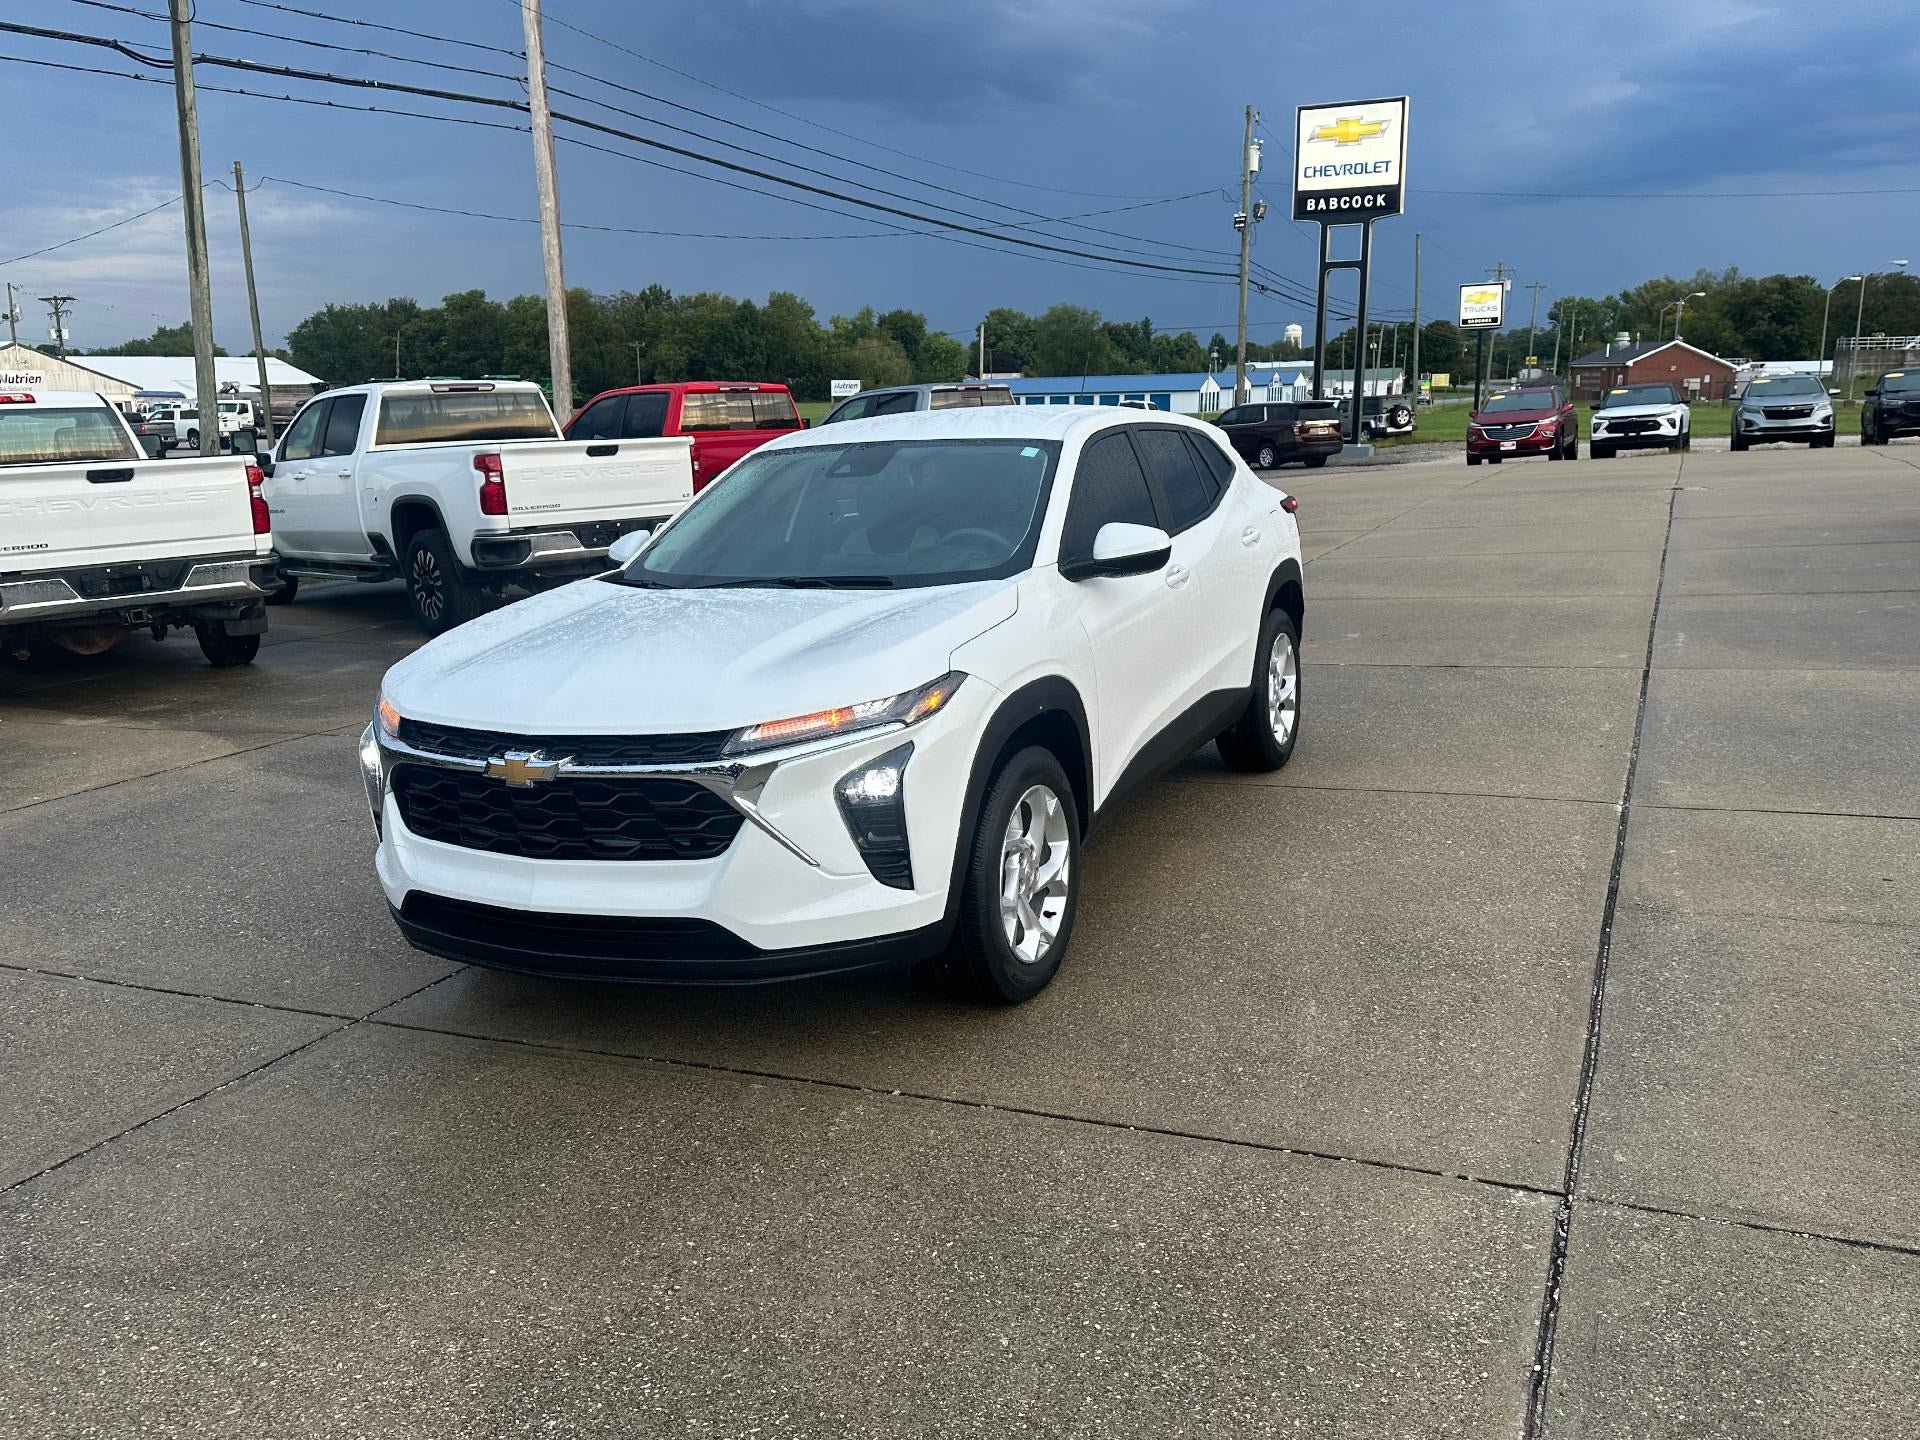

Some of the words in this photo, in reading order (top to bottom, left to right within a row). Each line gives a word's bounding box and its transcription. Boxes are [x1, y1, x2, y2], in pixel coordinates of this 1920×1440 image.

[1304, 160, 1392, 179] CHEVROLET
[1306, 193, 1386, 211] BABCOCK
[1464, 305, 1498, 313] TRUCKS
[0, 372, 42, 384] Nutrien
[512, 503, 561, 512] SILVERADO
